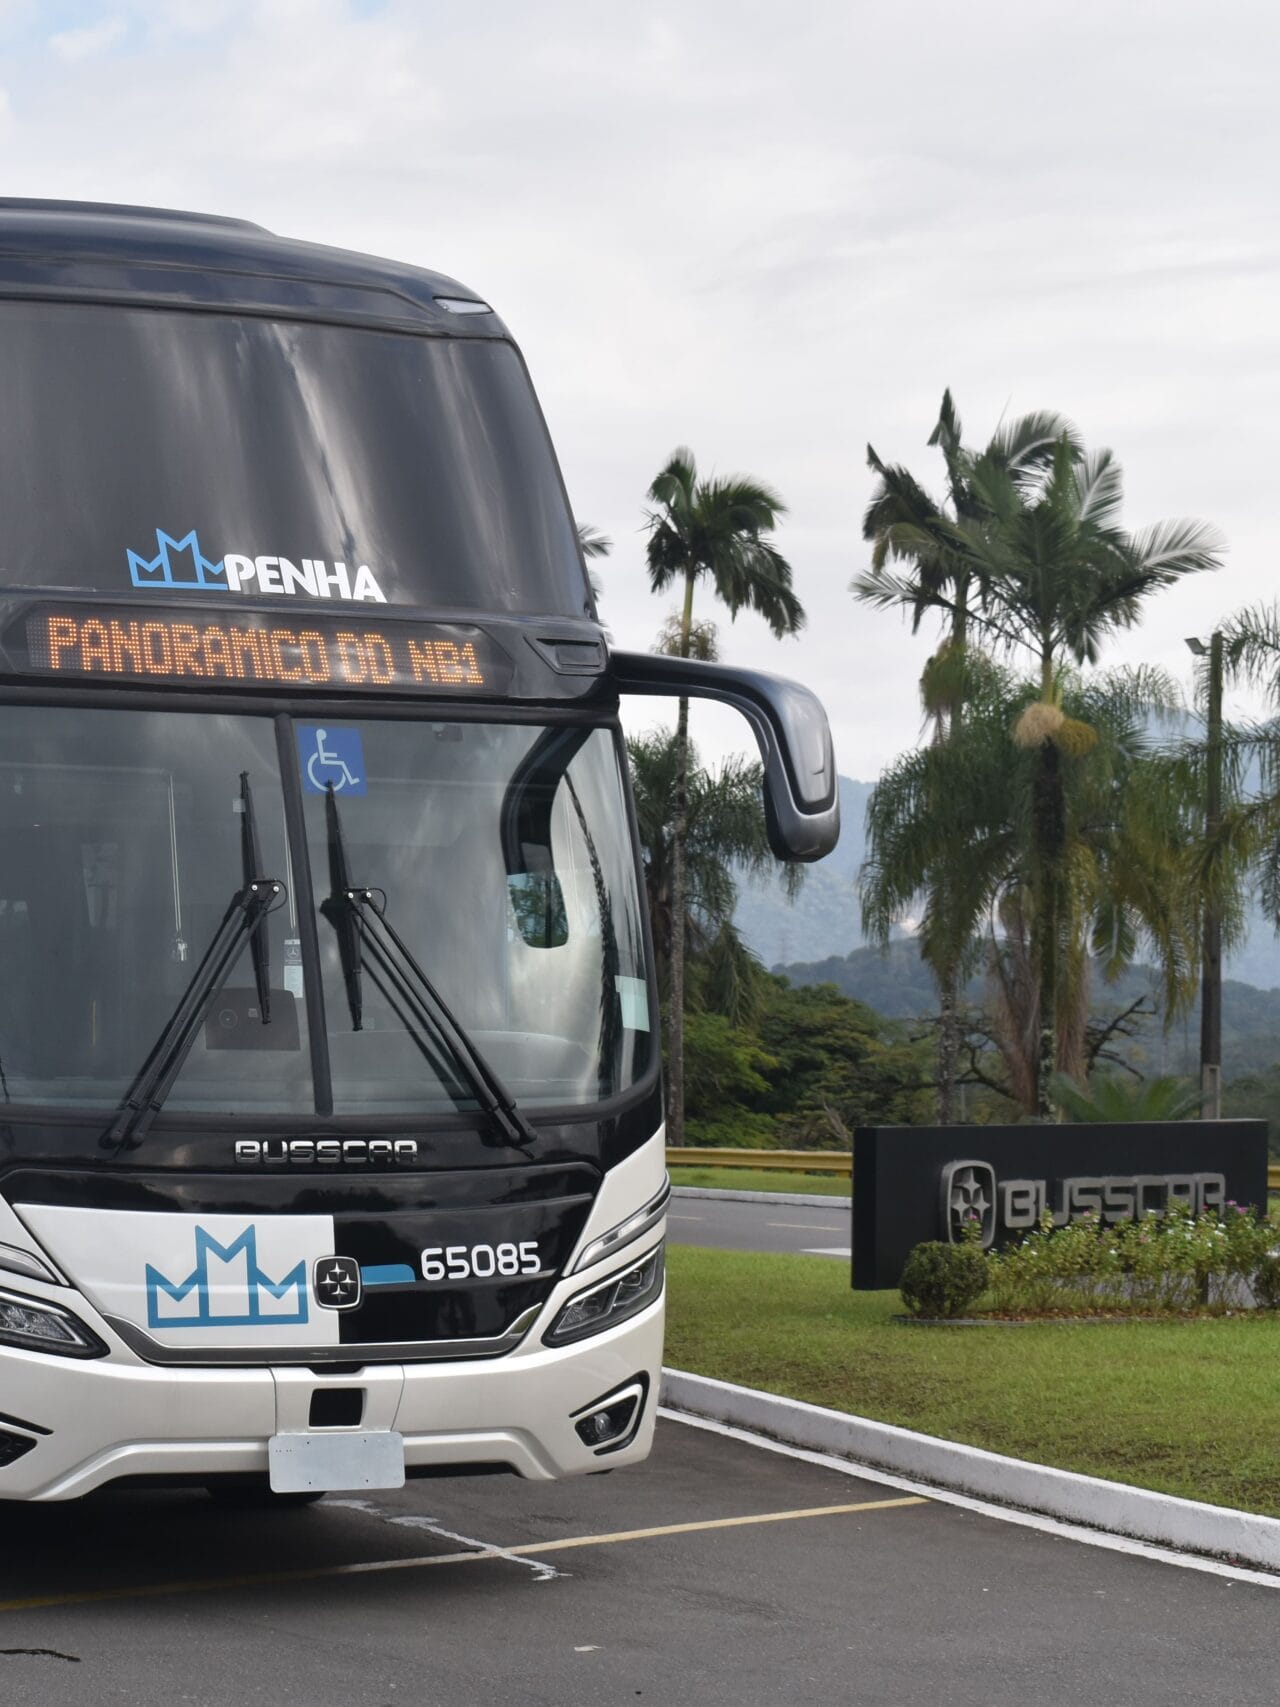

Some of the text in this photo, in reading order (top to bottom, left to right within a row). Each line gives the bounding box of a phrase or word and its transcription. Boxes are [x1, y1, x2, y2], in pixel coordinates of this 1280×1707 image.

[223, 553, 389, 604] PENHA
[48, 617, 329, 682] PANORAMICO
[336, 632, 396, 684] DD
[234, 1139, 418, 1164] BUSSCAR
[998, 1172, 1226, 1228] BUSSCAR
[420, 1241, 542, 1281] 65085
